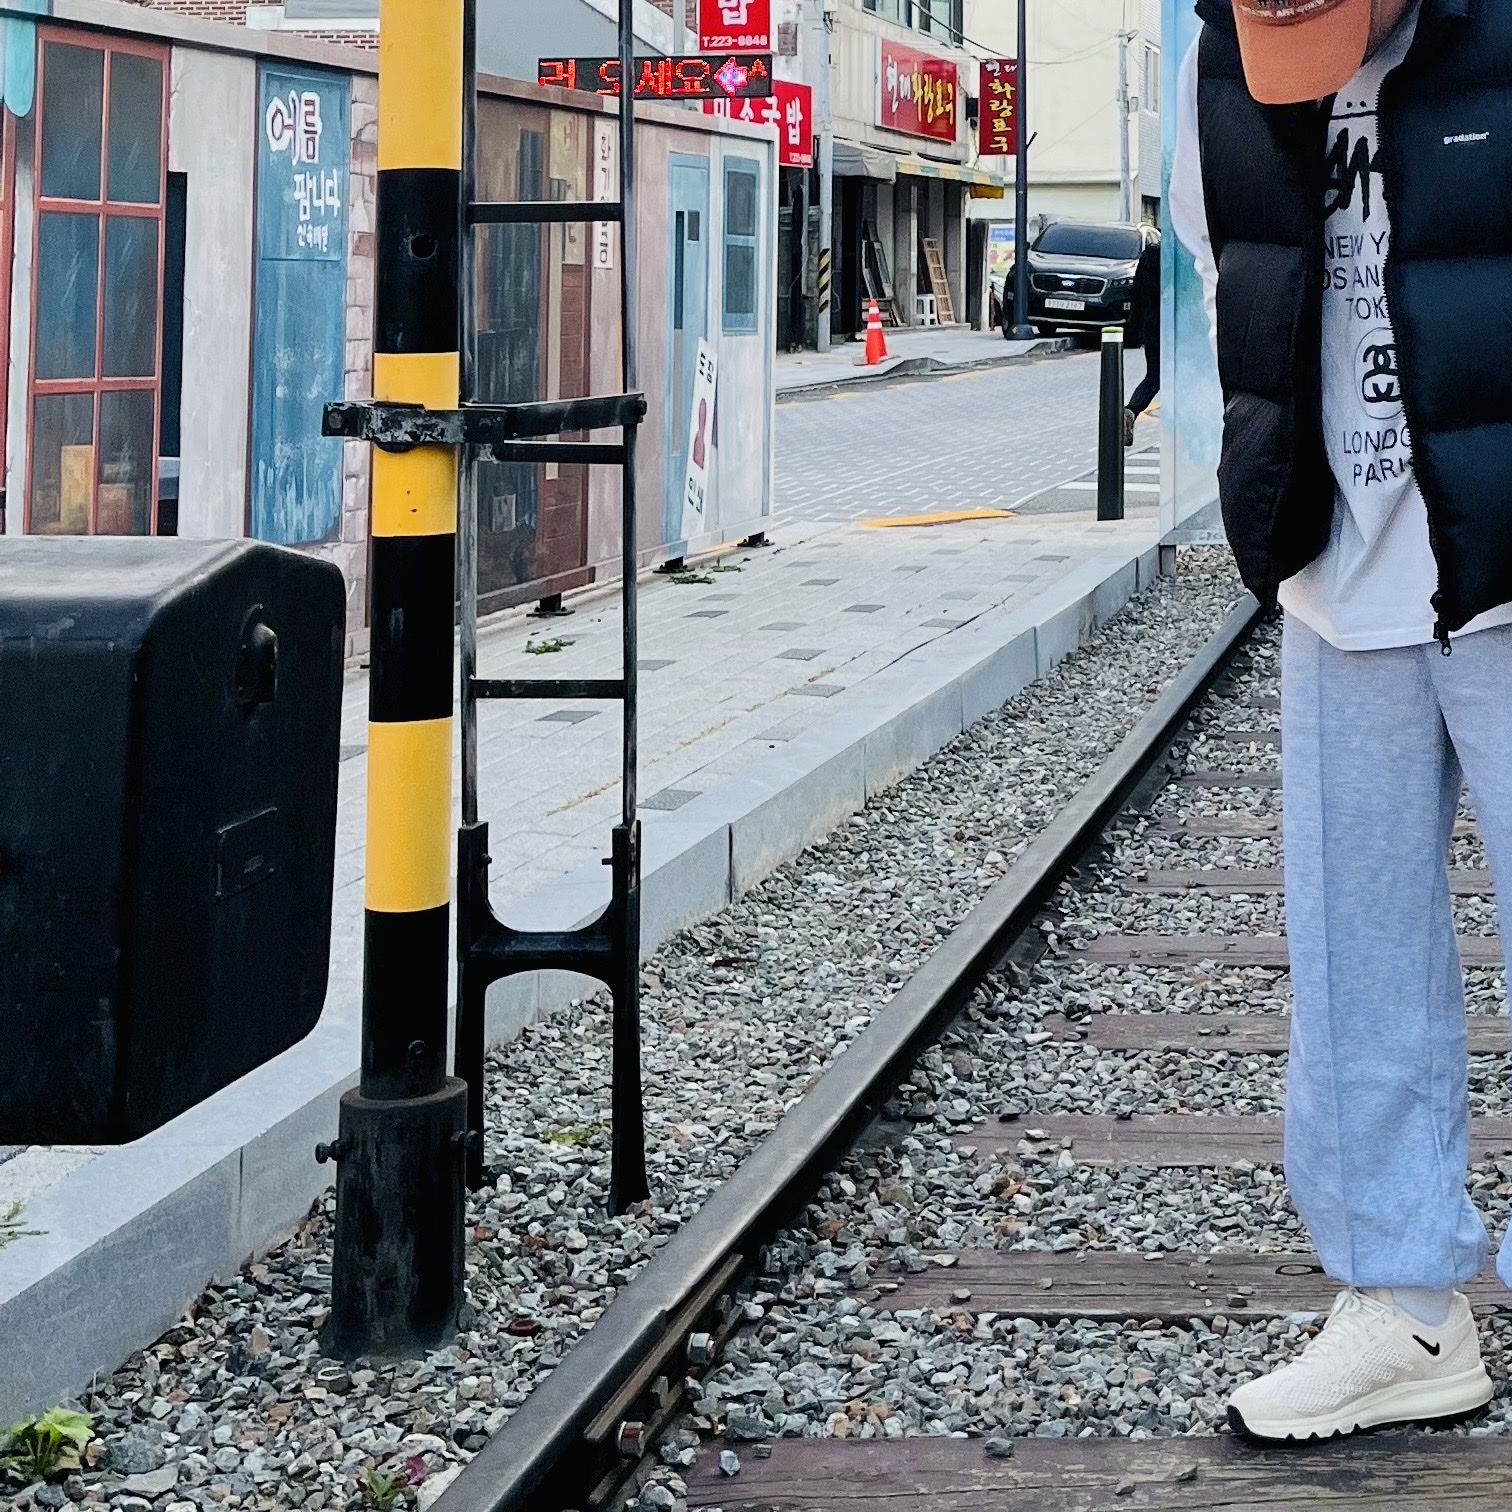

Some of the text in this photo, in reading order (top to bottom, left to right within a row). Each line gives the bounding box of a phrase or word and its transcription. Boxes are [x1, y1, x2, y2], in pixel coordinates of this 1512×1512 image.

[1345, 296, 1388, 320] TOK
[1343, 427, 1412, 454] LONDO
[1353, 457, 1407, 487] PARI
